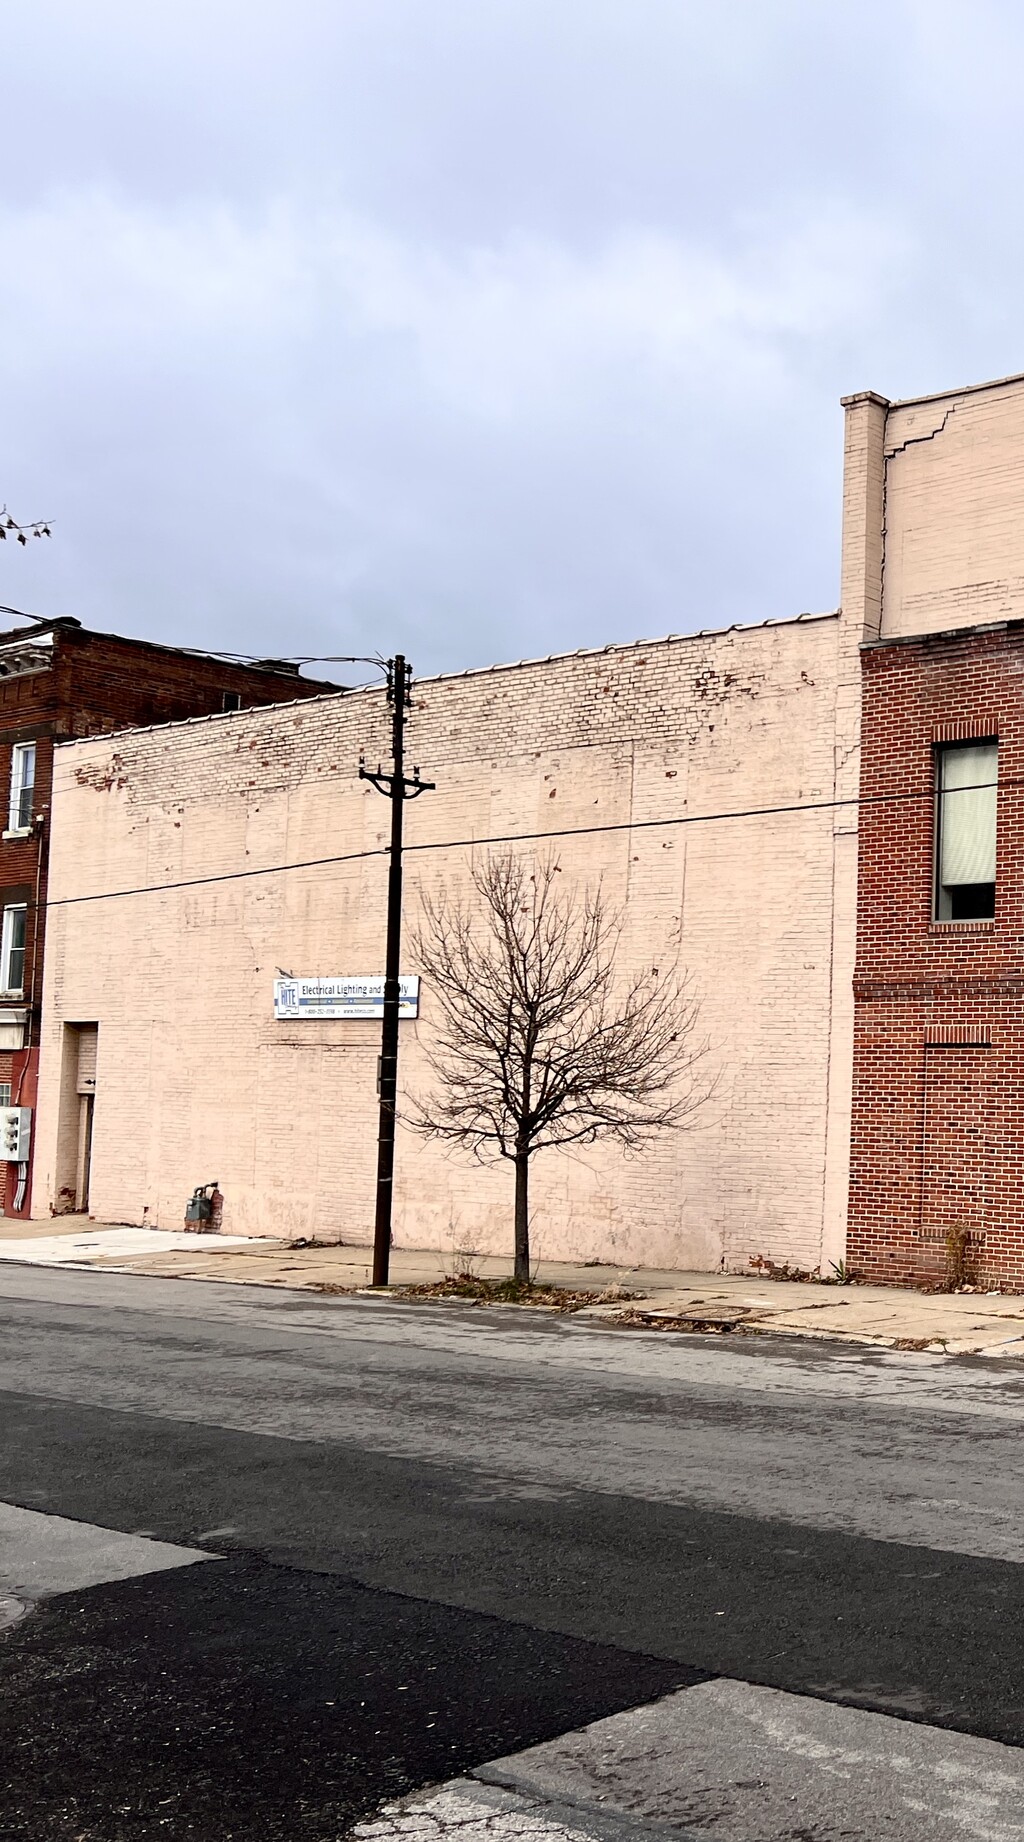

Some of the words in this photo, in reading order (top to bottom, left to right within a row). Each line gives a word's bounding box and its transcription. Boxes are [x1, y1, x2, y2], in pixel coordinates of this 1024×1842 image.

[281, 989, 296, 1005] HITE
[302, 985, 335, 995] Electrical
[337, 984, 367, 997] Lighting
[368, 985, 381, 994] and
